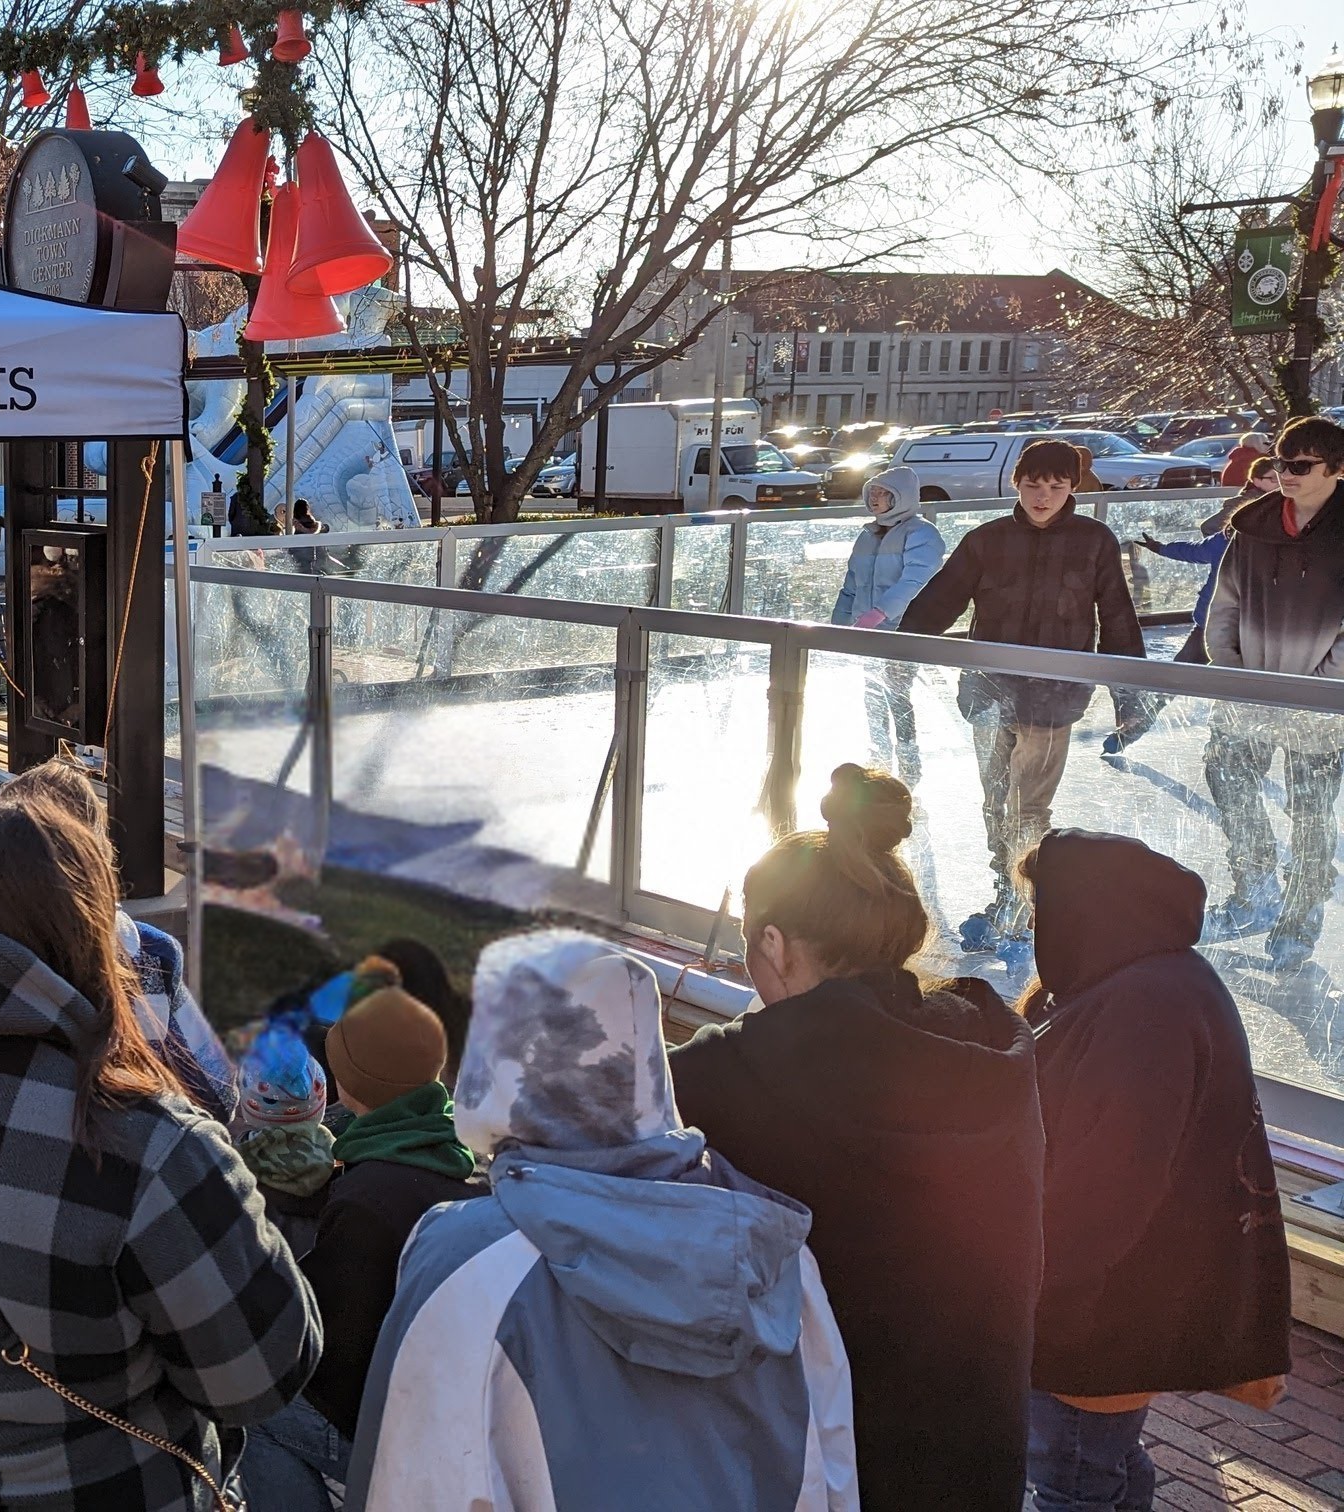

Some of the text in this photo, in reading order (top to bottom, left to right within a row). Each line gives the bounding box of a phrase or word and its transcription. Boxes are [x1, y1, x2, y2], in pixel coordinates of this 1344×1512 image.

[24, 217, 81, 246] DICKMANN
[37, 241, 68, 263] TOWN
[31, 261, 74, 284] CENTER
